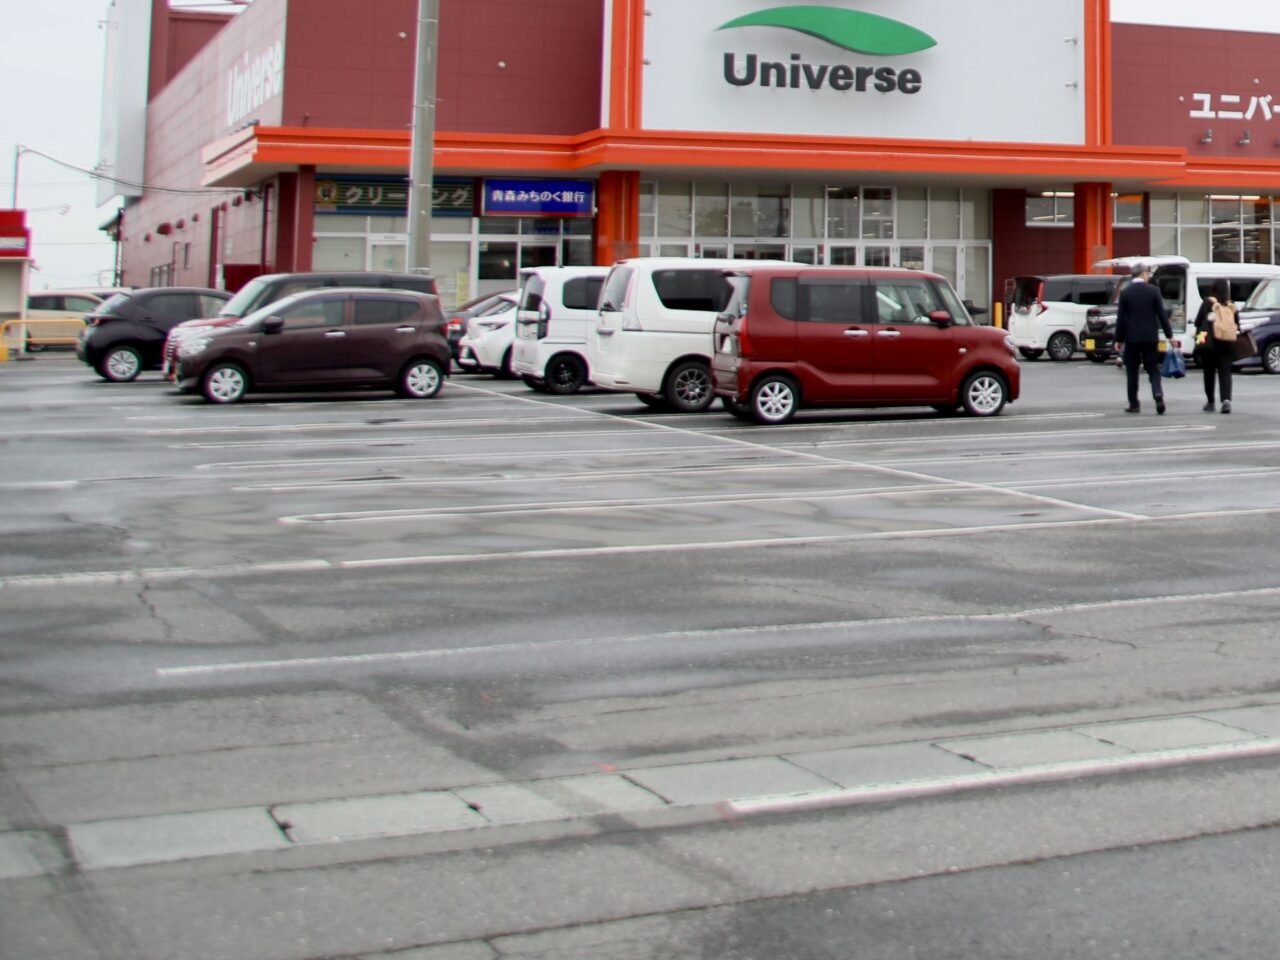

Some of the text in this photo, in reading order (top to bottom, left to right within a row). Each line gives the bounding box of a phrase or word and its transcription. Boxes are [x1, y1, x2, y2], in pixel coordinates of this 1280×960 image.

[227, 40, 284, 127] Universe
[723, 52, 922, 94] Universe
[345, 185, 471, 206] クリーング
[492, 189, 585, 203] 青森みちのく銀行
